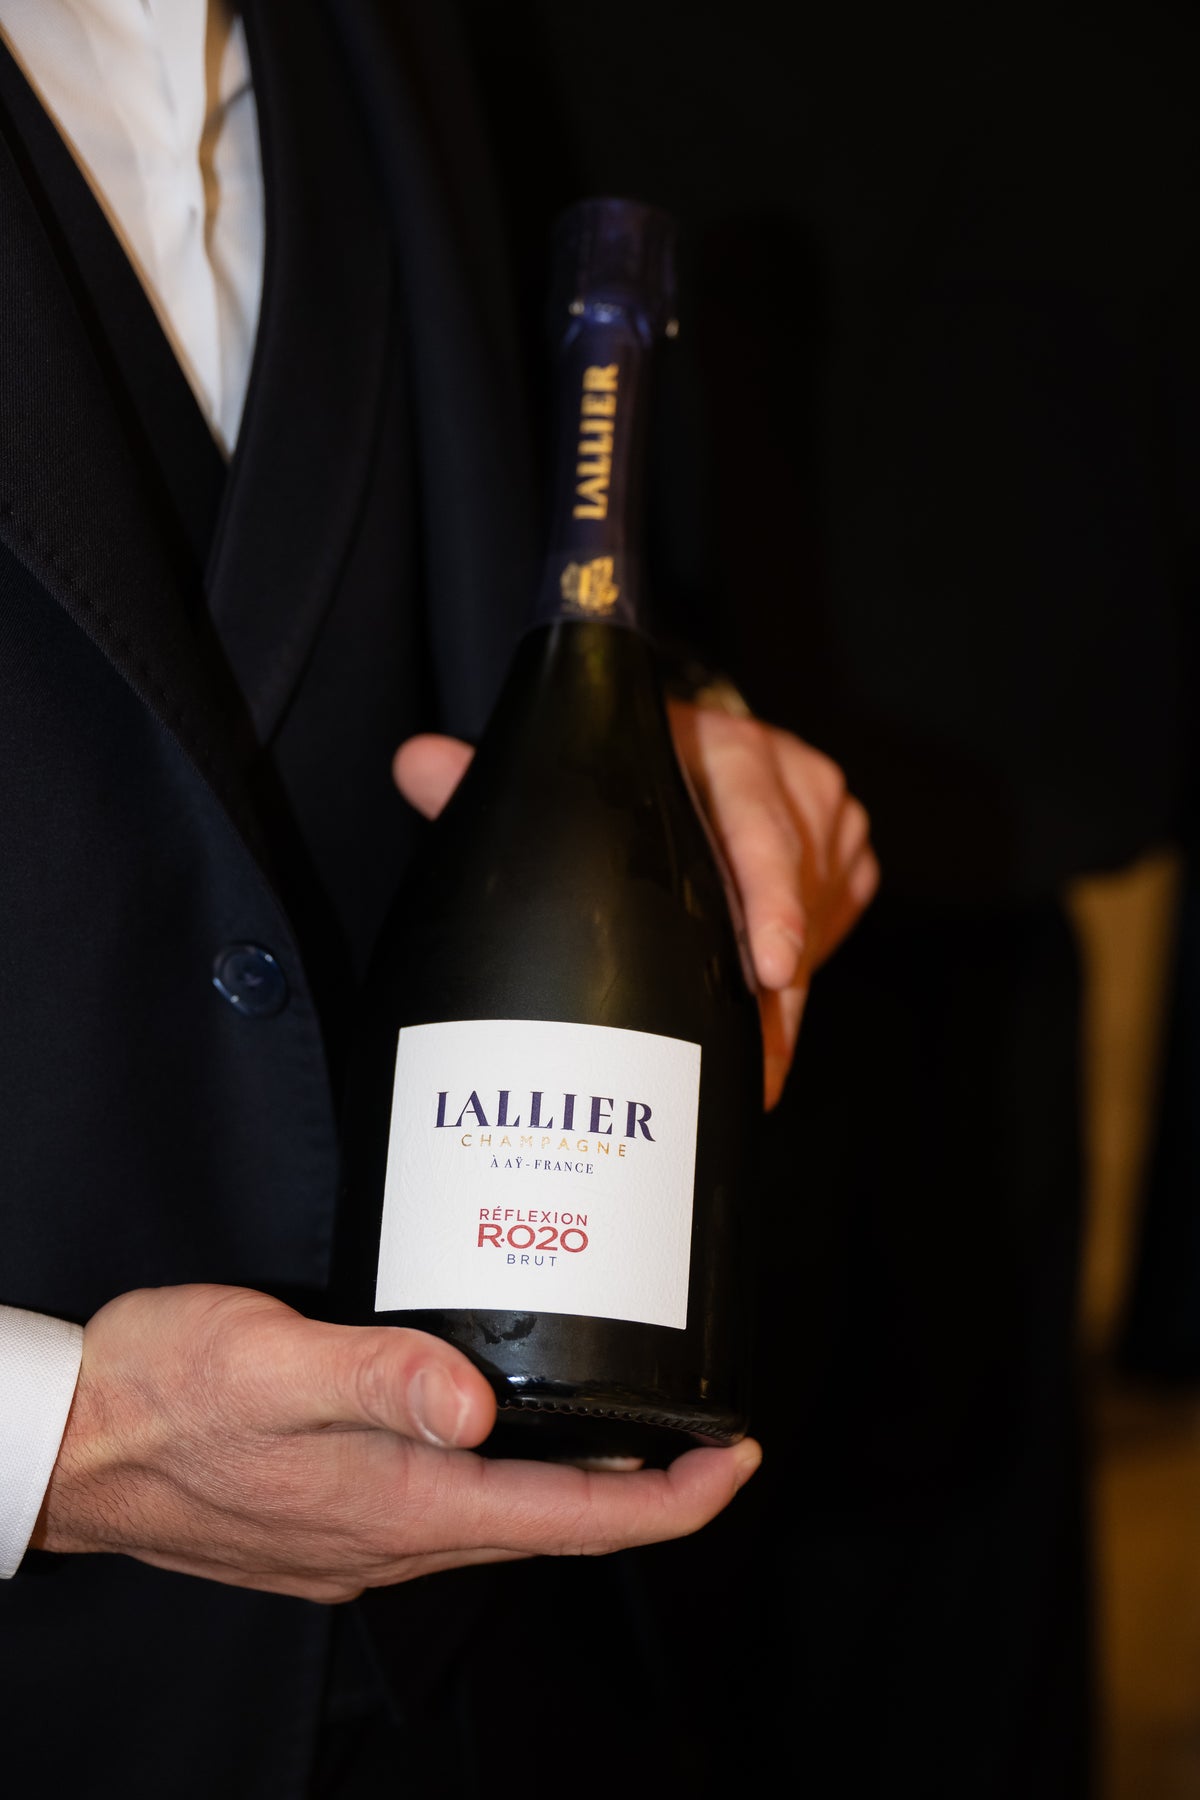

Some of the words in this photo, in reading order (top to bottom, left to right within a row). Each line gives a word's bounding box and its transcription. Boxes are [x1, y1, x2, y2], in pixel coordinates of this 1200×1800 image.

[573, 363, 619, 519] LALLIER
[434, 1090, 656, 1142] LALLIER
[461, 1134, 626, 1157] CHAMPAGNE
[490, 1154, 499, 1169] À
[479, 1206, 588, 1226] RÉFLEXION
[506, 1253, 558, 1267] BRUT
